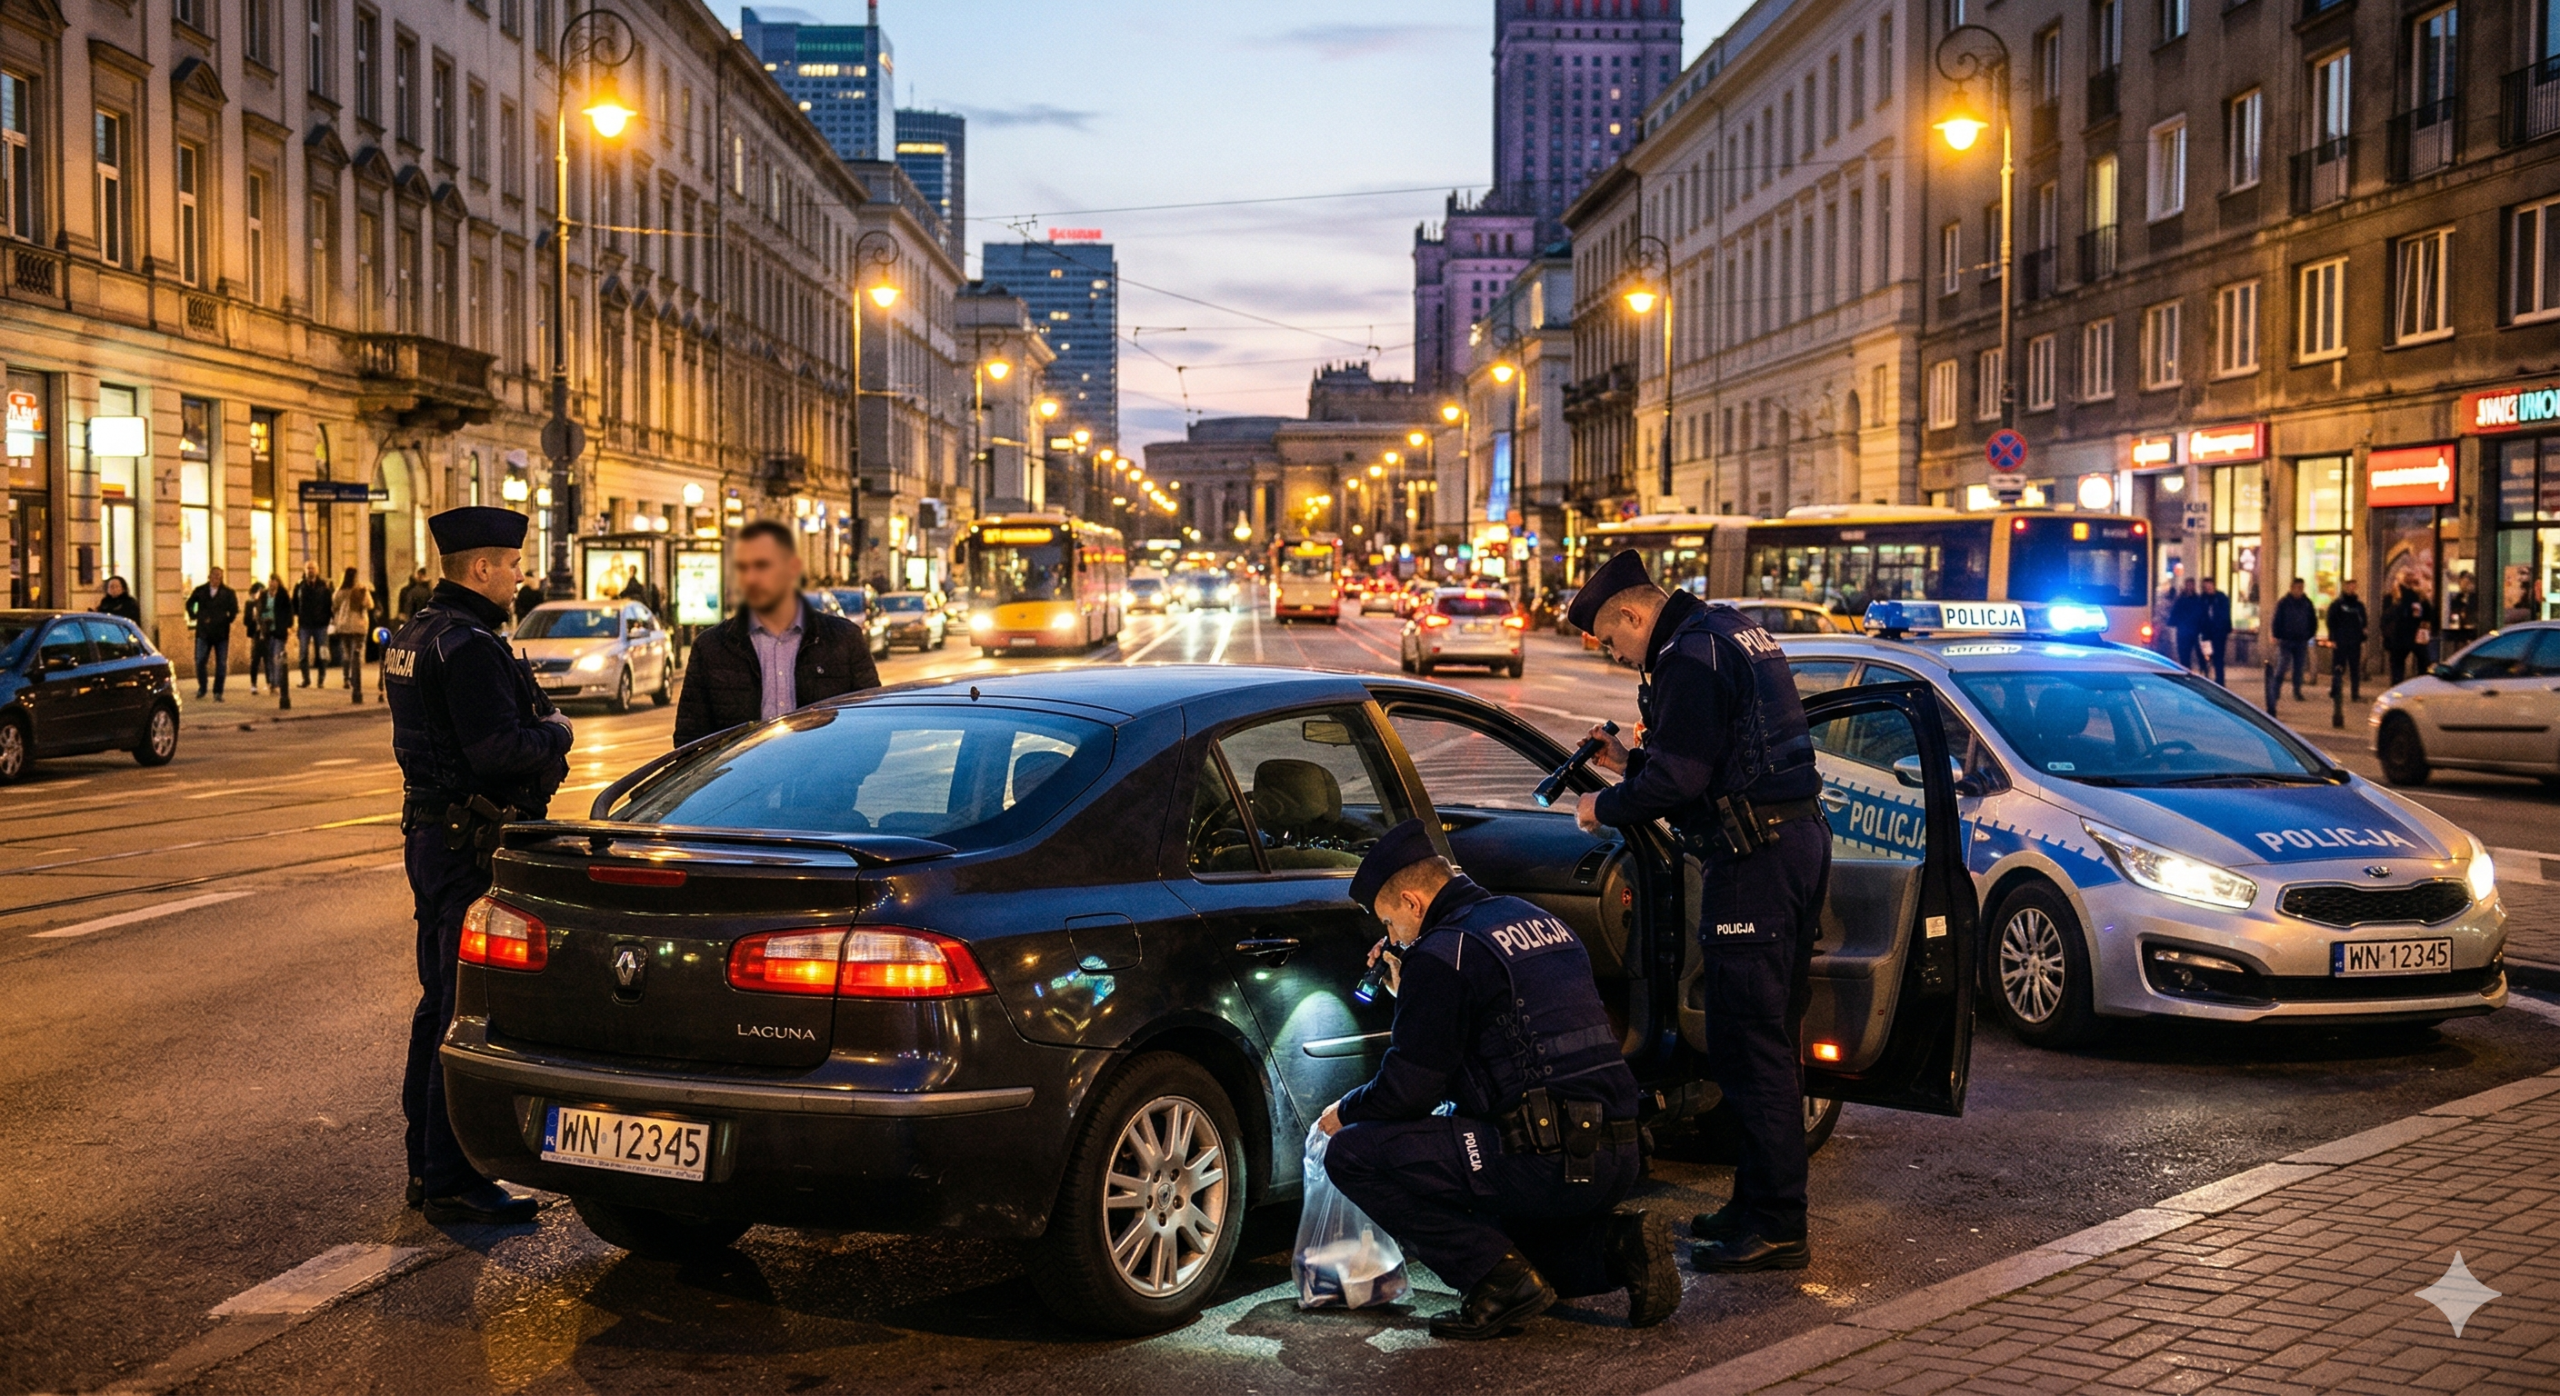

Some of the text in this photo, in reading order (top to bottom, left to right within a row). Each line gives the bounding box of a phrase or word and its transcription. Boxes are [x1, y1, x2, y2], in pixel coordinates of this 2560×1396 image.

[1946, 608, 2021, 626] POLICJA
[2255, 827, 2418, 853] POLICJA
[1491, 918, 1574, 956] POLICJA
[1716, 922, 1755, 935] POLICJA
[2349, 942, 2448, 970] WN 12345
[737, 1023, 816, 1041] LAGUNA
[561, 1112, 600, 1155] WN
[613, 1119, 702, 1168] 12345
[1463, 1132, 1483, 1171] POLICJA
